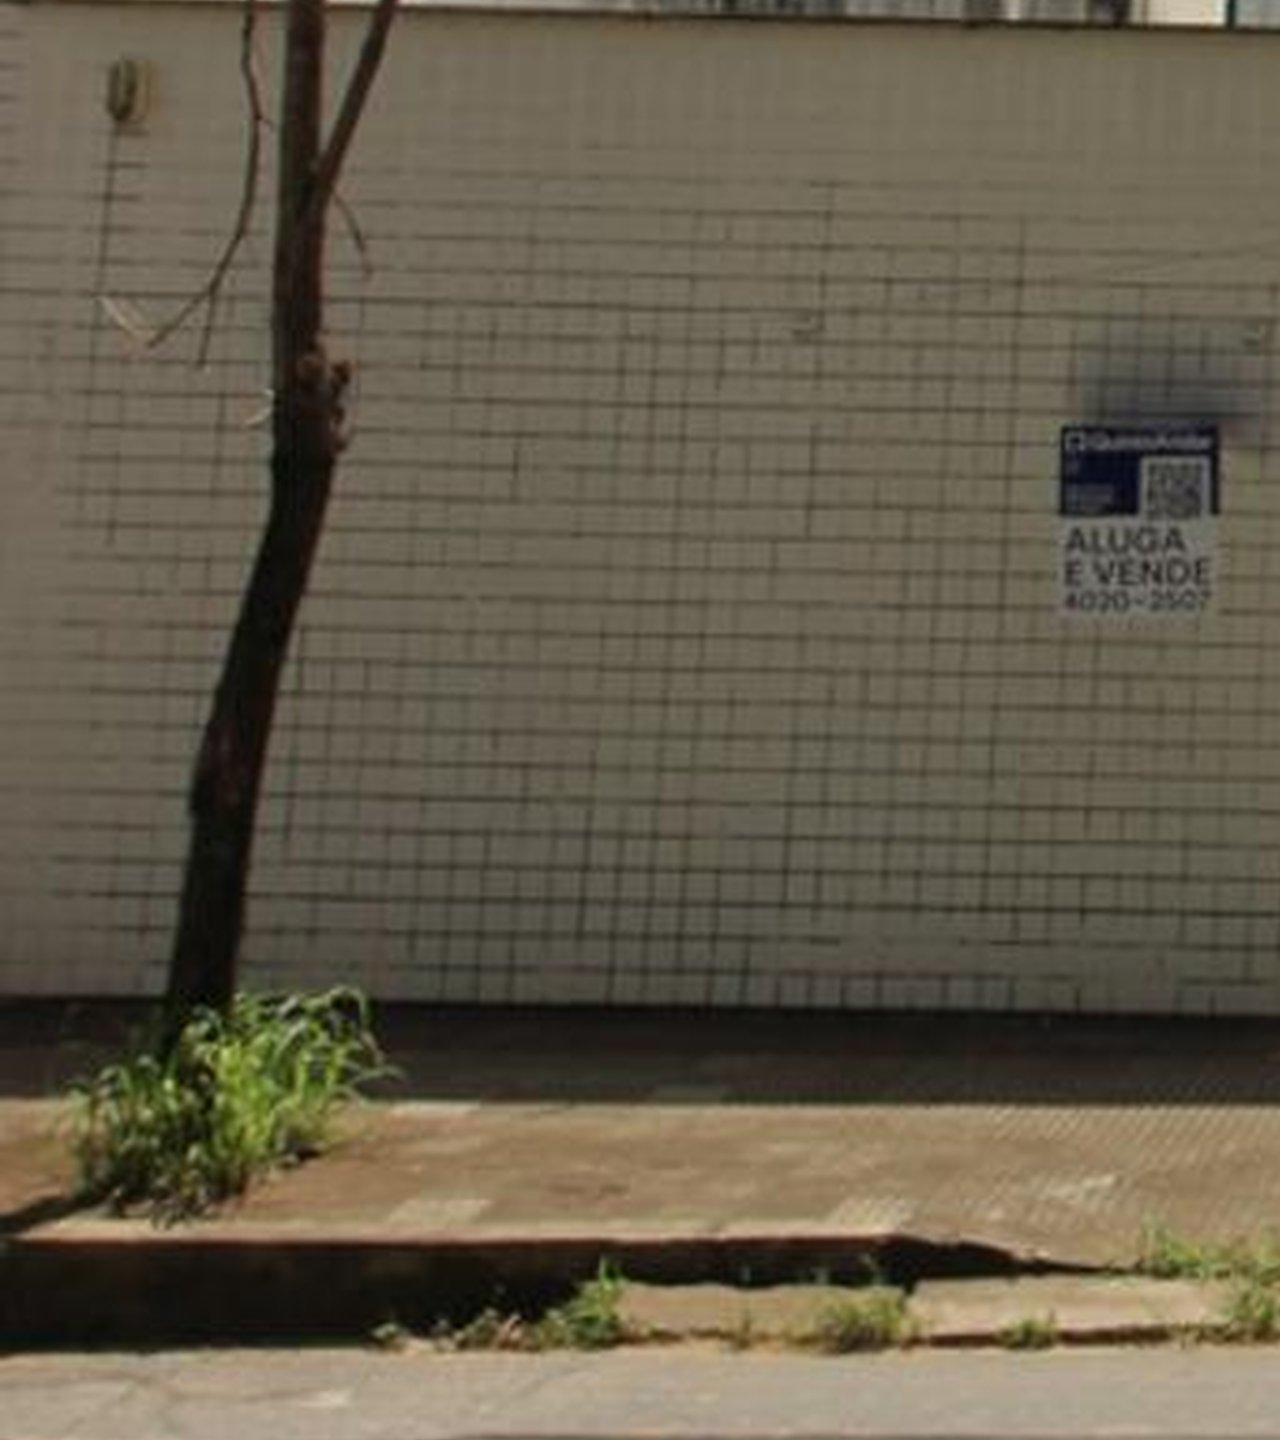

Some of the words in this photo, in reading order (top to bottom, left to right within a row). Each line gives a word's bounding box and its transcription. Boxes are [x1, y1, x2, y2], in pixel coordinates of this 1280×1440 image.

[1065, 527, 1187, 553] ALUGA
[1065, 558, 1082, 587] E
[1092, 556, 1212, 586] VENDE
